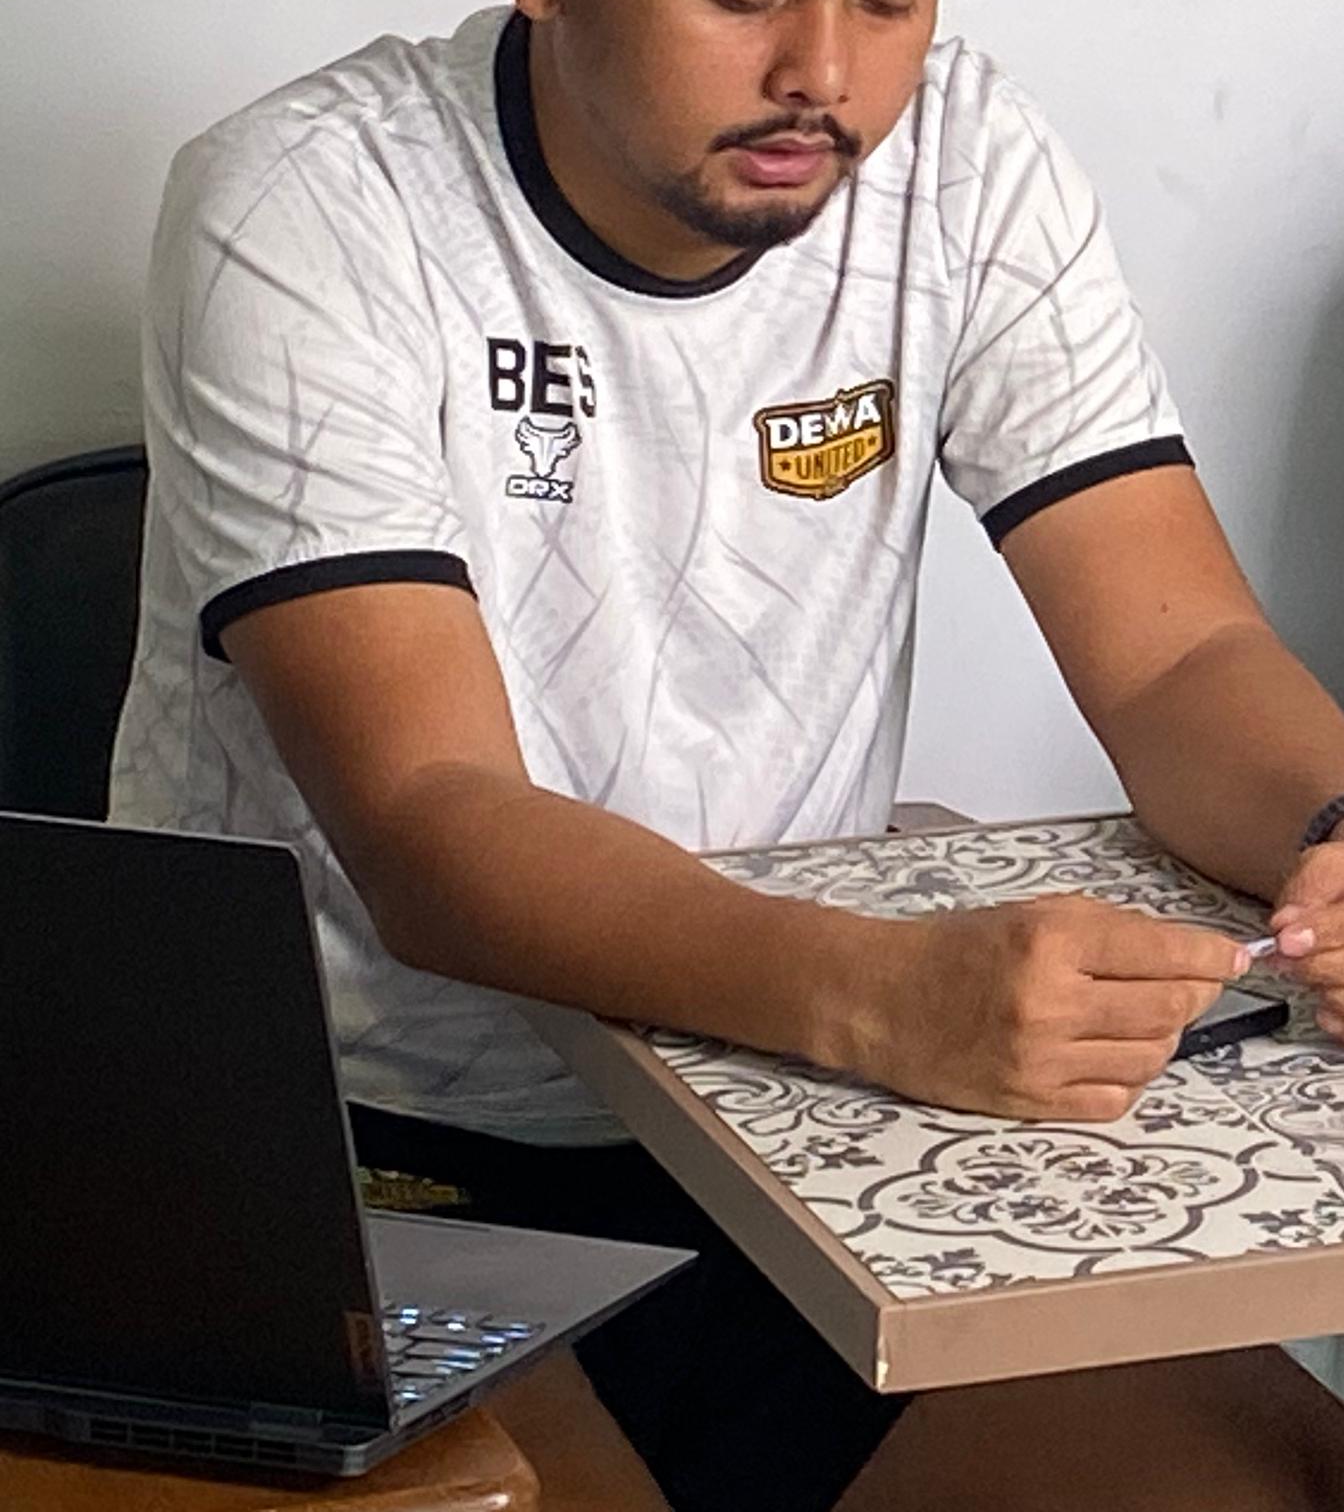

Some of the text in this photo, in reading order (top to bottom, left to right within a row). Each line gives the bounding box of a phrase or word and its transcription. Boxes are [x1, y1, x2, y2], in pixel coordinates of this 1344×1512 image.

[486, 336, 597, 418] BES
[765, 393, 882, 450] DEWA
[794, 436, 866, 480] UNITED
